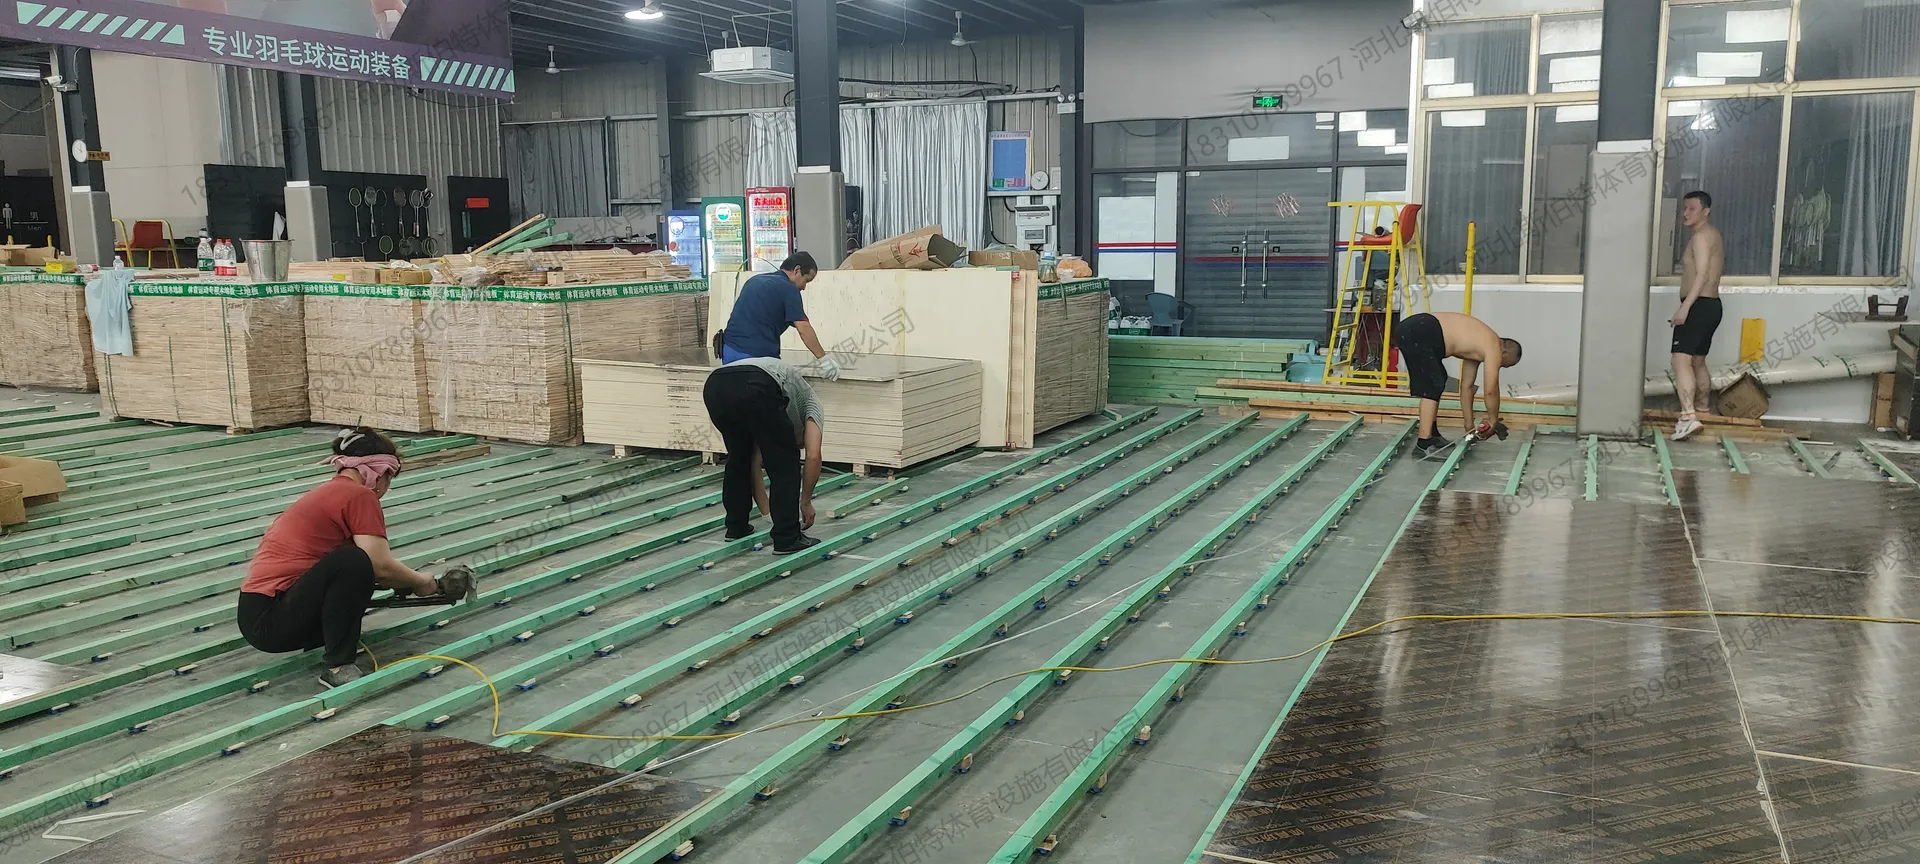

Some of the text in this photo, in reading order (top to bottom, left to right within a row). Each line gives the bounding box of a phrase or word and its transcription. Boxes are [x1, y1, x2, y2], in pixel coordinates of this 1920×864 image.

[202, 26, 412, 80] 专业羽毛球运动装备
[30, 211, 39, 221] 男
